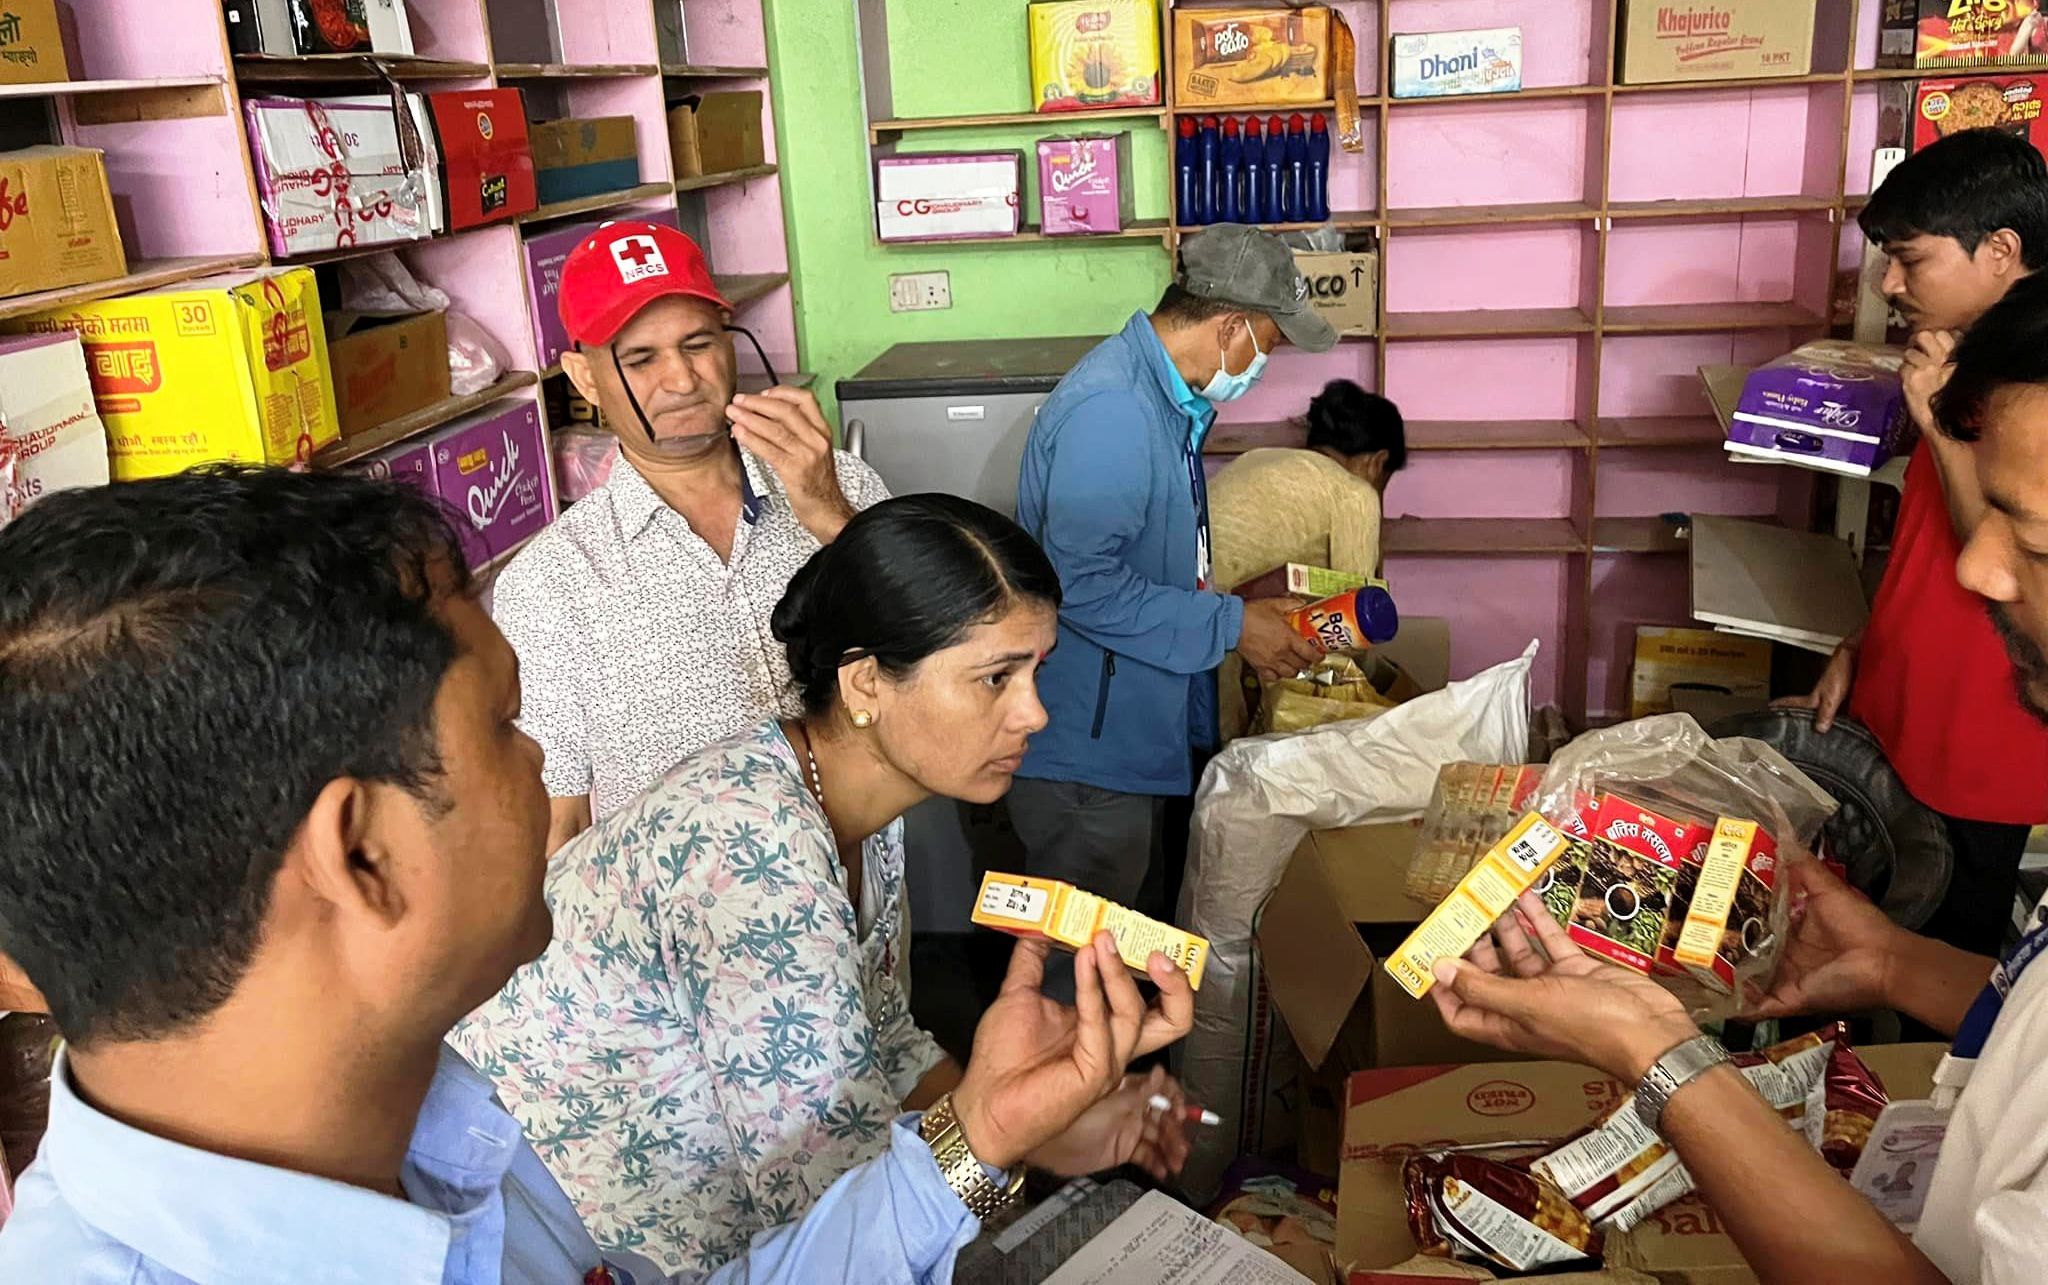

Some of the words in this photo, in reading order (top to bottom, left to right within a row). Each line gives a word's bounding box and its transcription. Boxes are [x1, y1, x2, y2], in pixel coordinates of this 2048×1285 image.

[1657, 6, 1730, 36] Khajurico
[897, 199, 931, 216] CG
[625, 263, 665, 281] NRCS
[181, 306, 207, 324] 30
[468, 429, 519, 531] Quick
